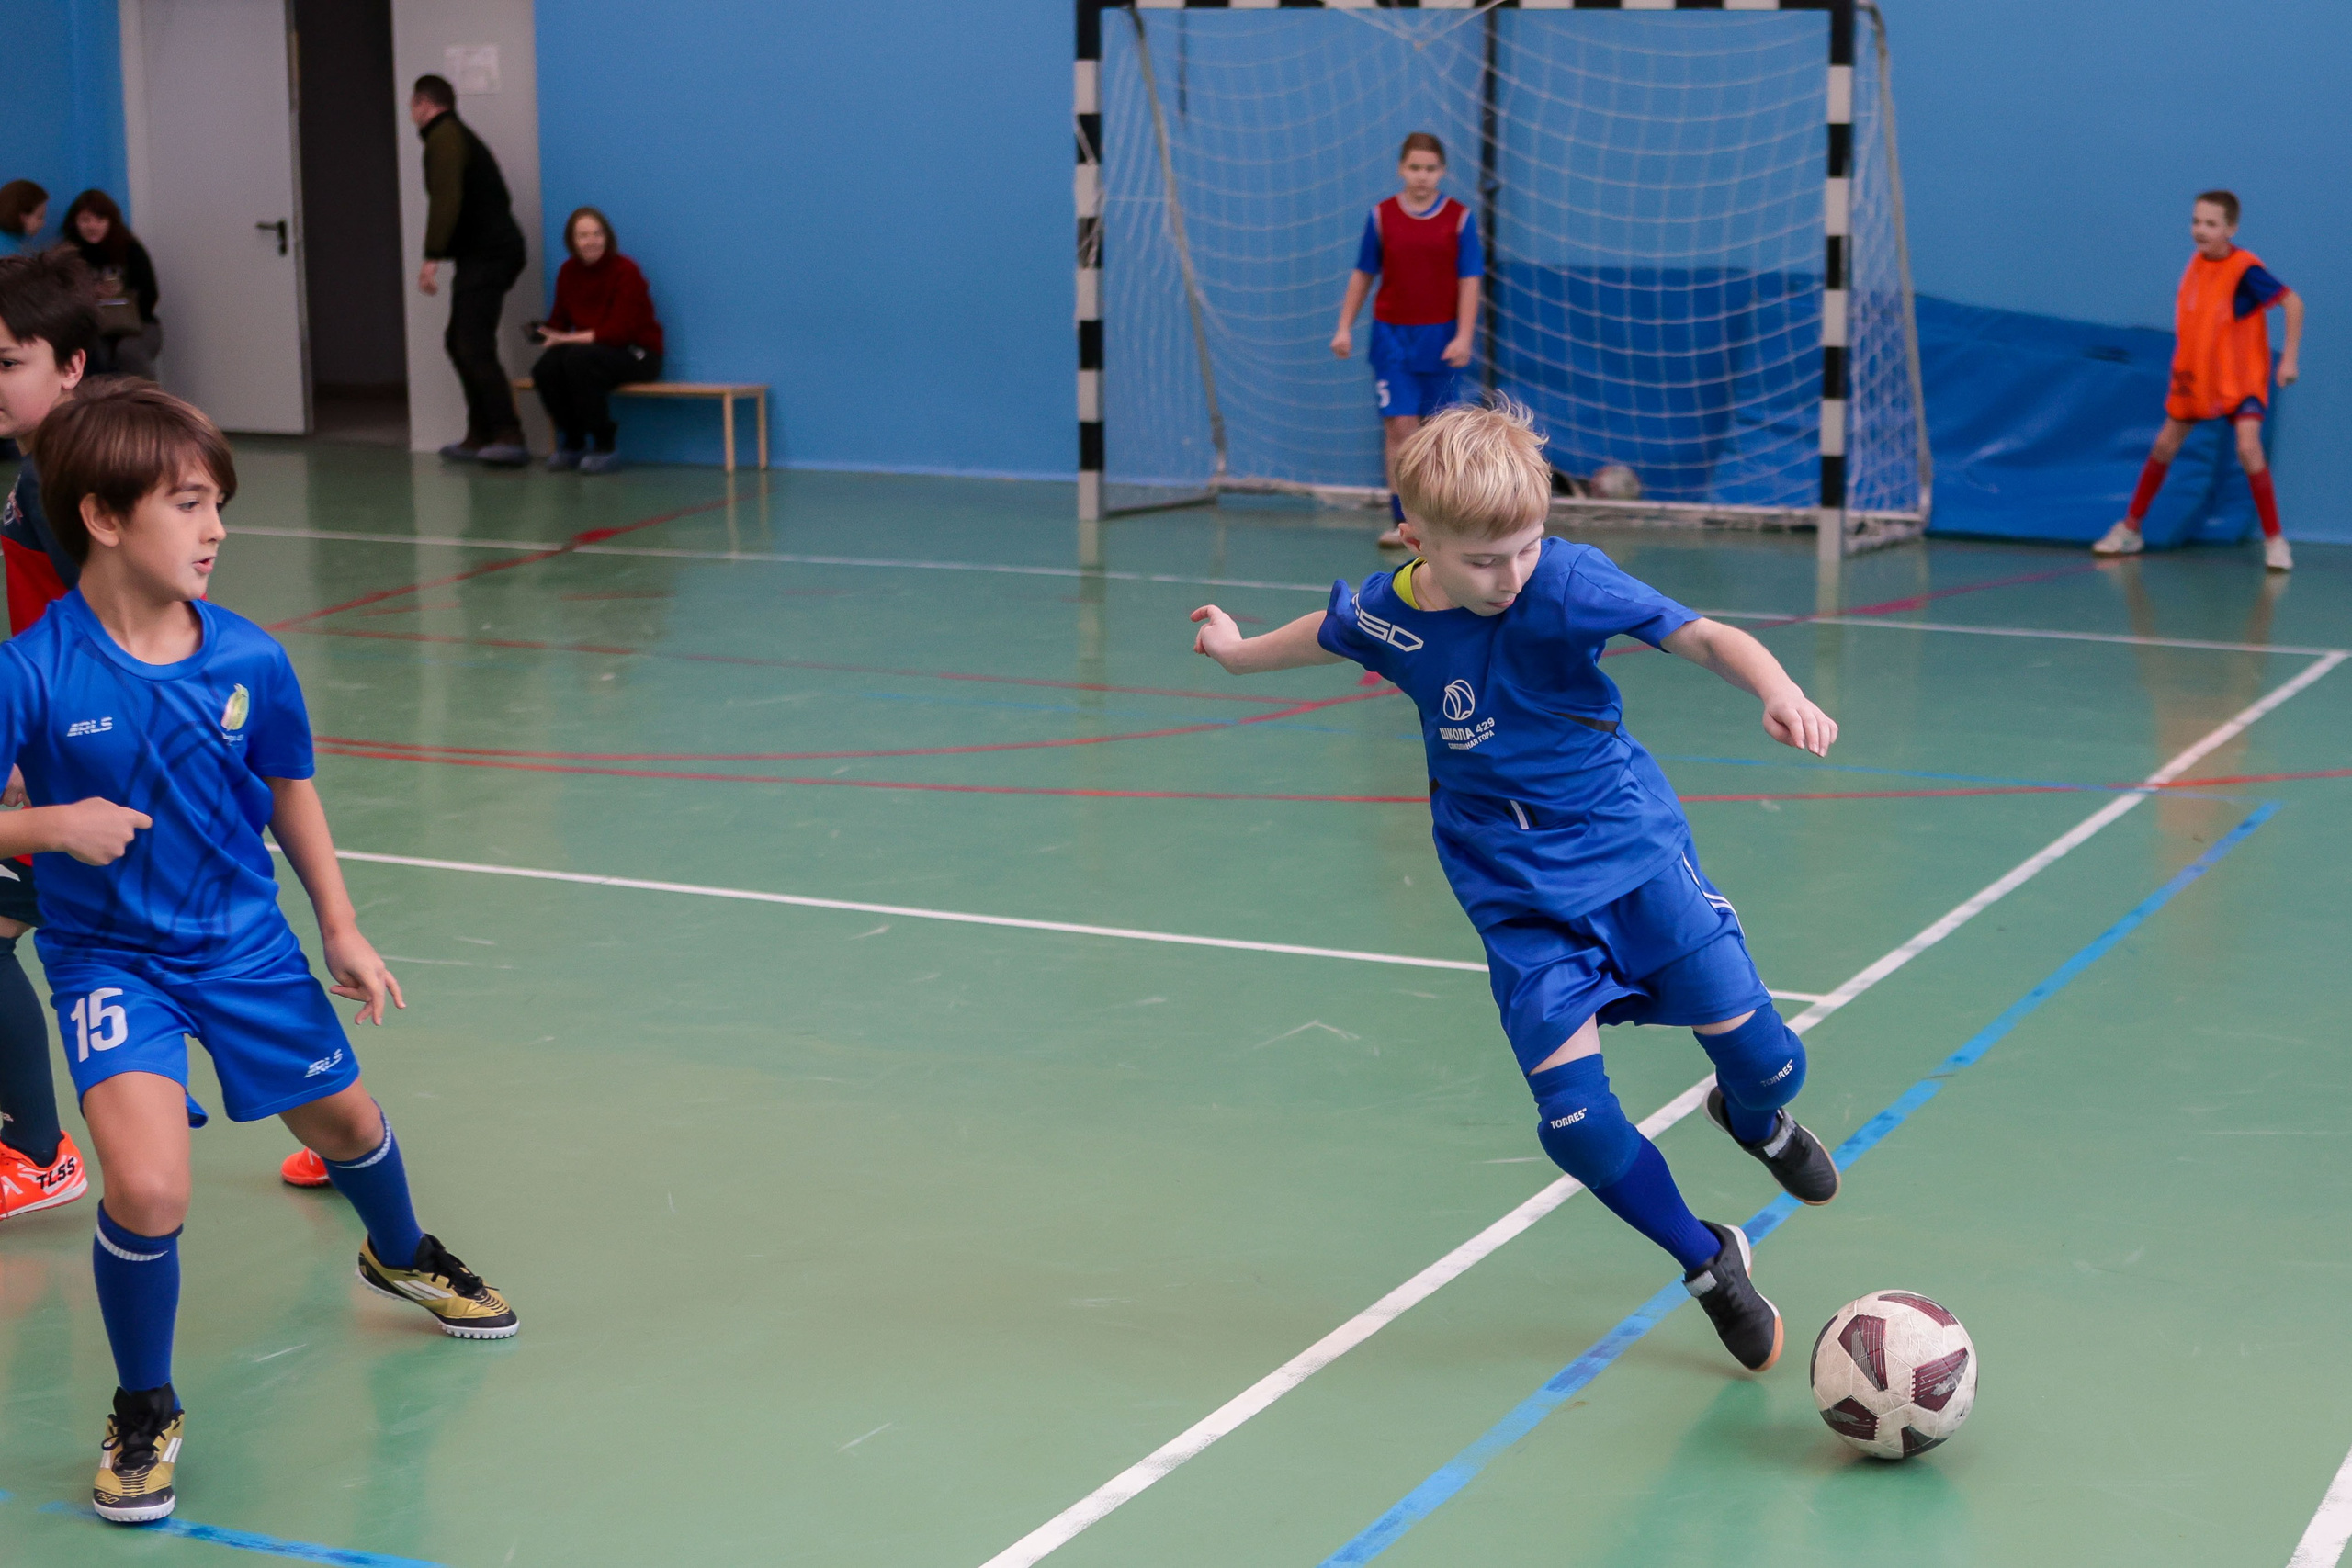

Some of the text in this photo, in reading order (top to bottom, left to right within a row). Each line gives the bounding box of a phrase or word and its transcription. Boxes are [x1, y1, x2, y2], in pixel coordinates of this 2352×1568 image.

[1439, 716, 1496, 741] ШКОЛА 429
[1477, 729, 1496, 743] ГОРА
[70, 987, 129, 1063] 15
